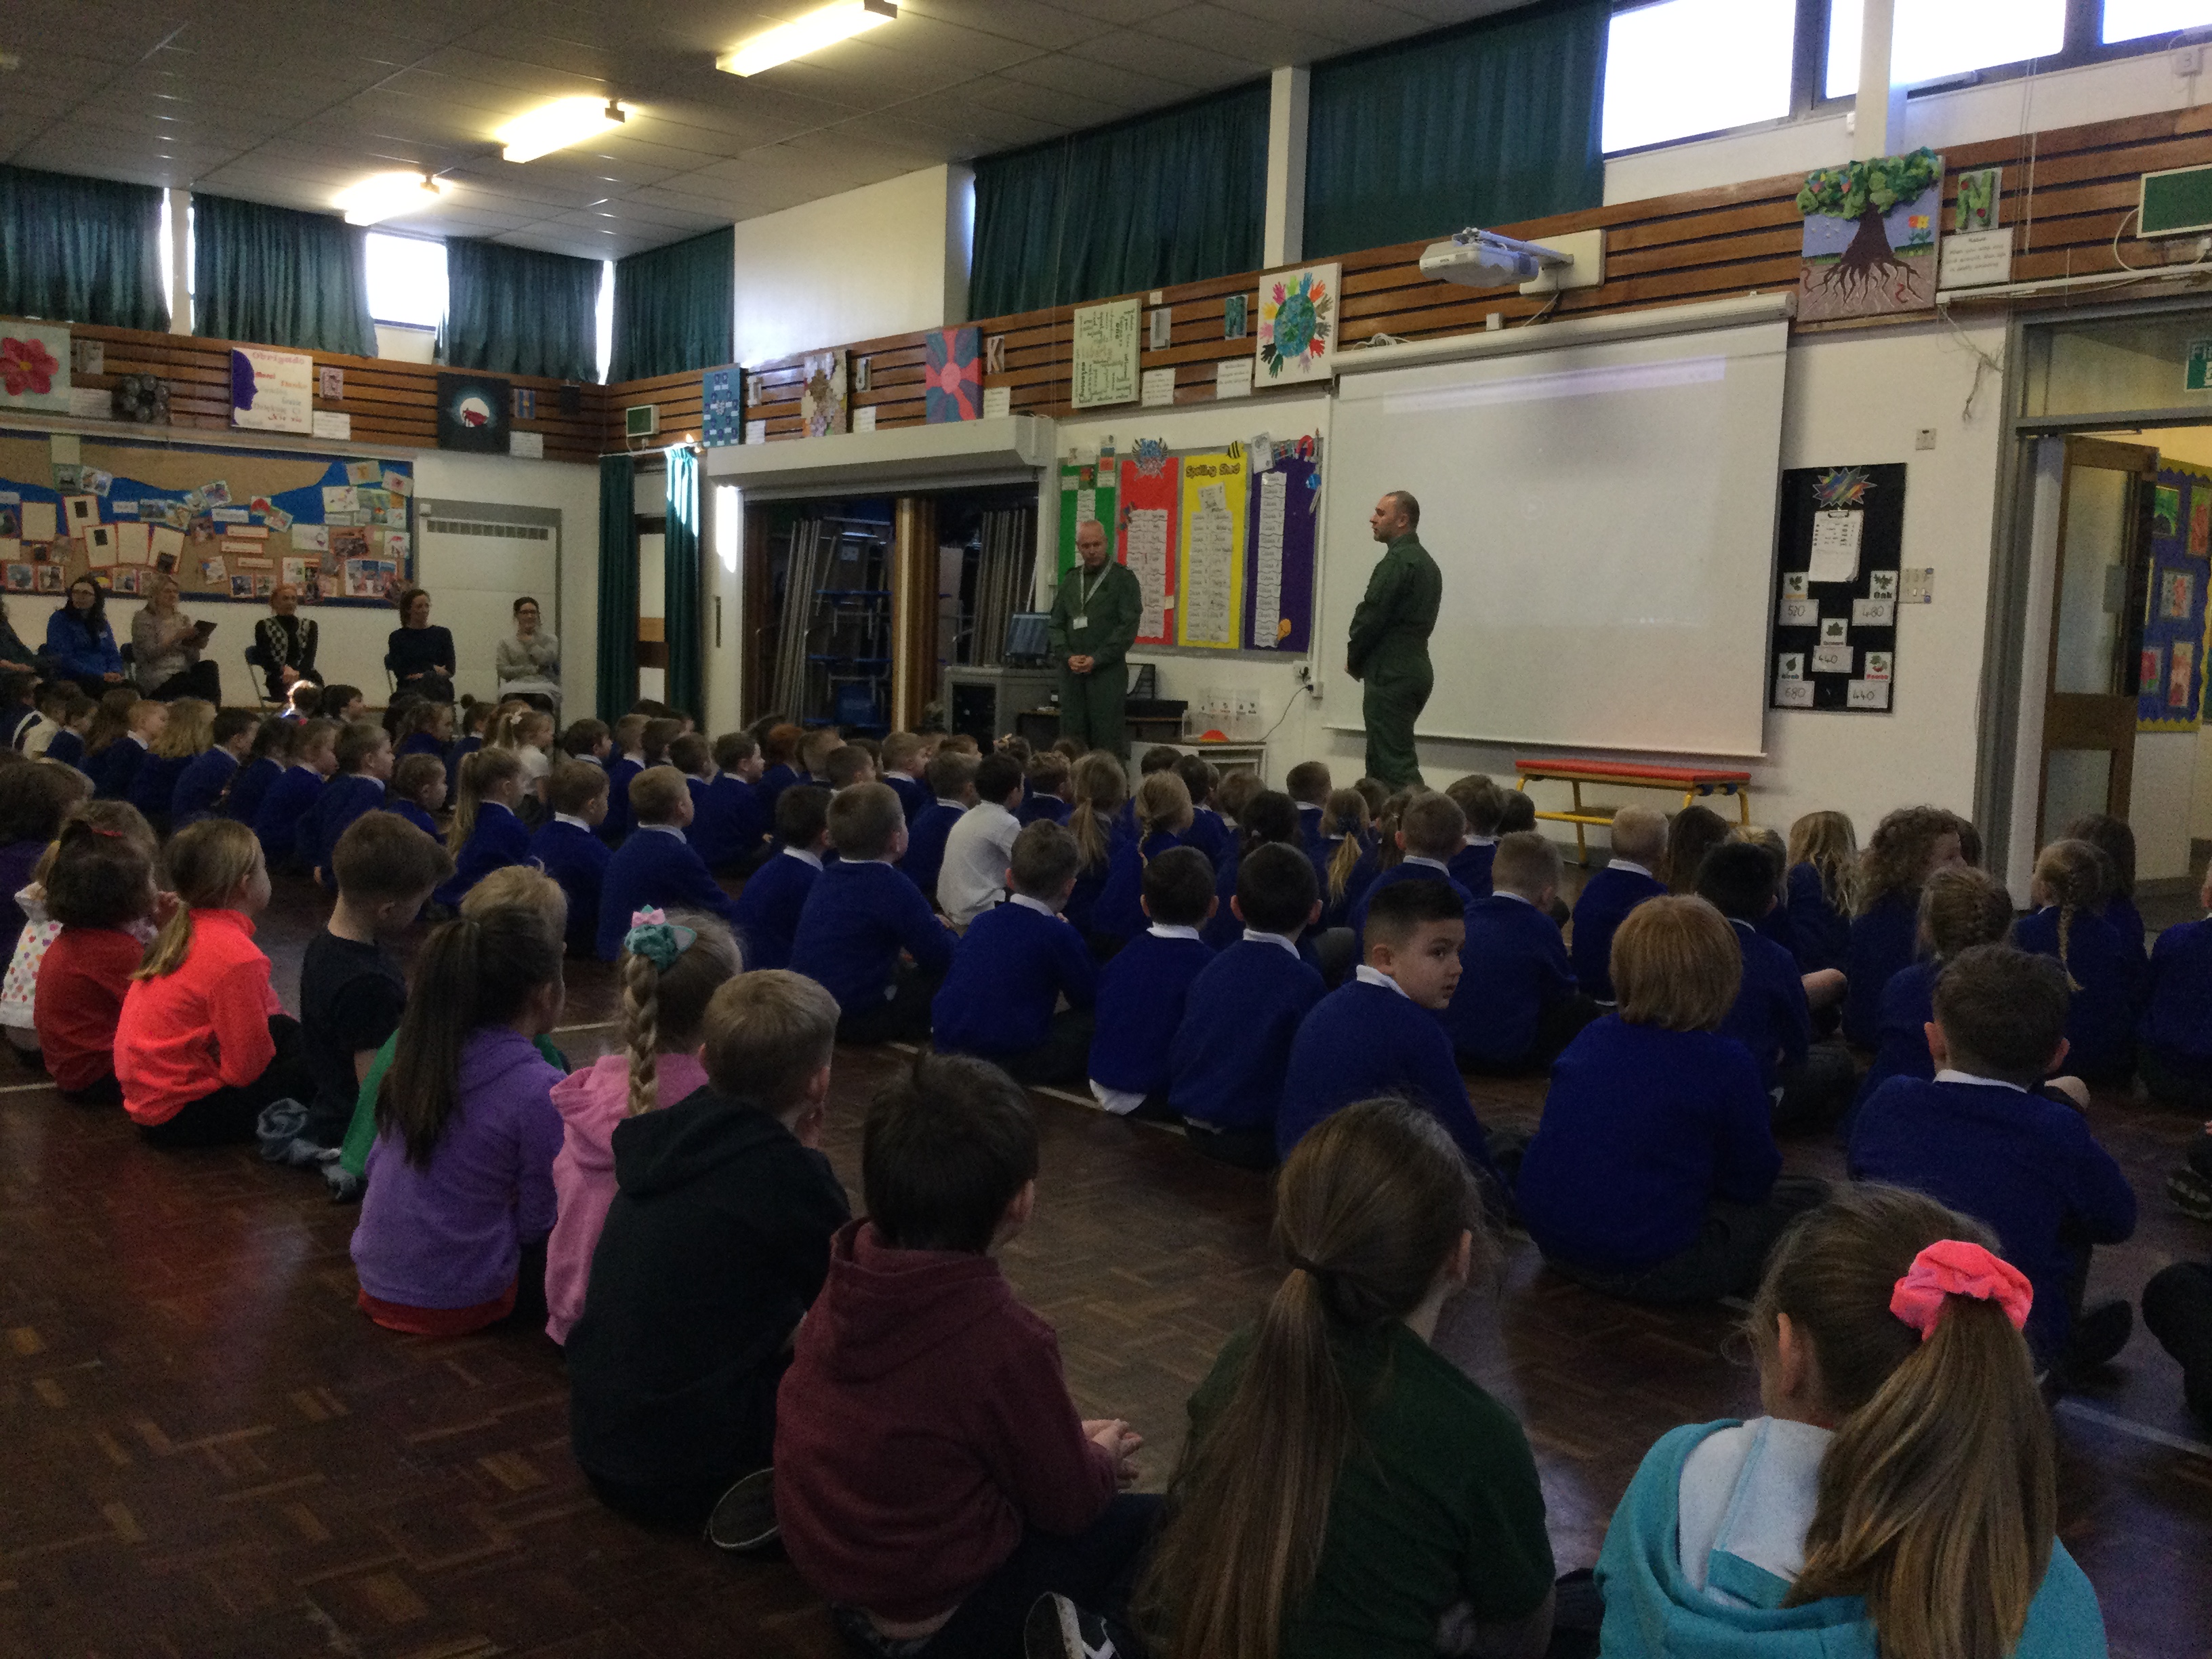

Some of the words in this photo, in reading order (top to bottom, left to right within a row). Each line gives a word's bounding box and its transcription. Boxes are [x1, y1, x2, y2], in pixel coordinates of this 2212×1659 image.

[1956, 171, 1994, 230] N
[1225, 296, 1246, 337] M
[252, 352, 304, 365] Obrigado
[987, 336, 1005, 373] K
[1186, 465, 1216, 479] Spelling
[1219, 463, 1240, 475] Shed
[1863, 605, 1885, 617] 480
[1818, 655, 1838, 664] 440
[1785, 687, 1807, 699] 680
[1852, 688, 1875, 701] 440
